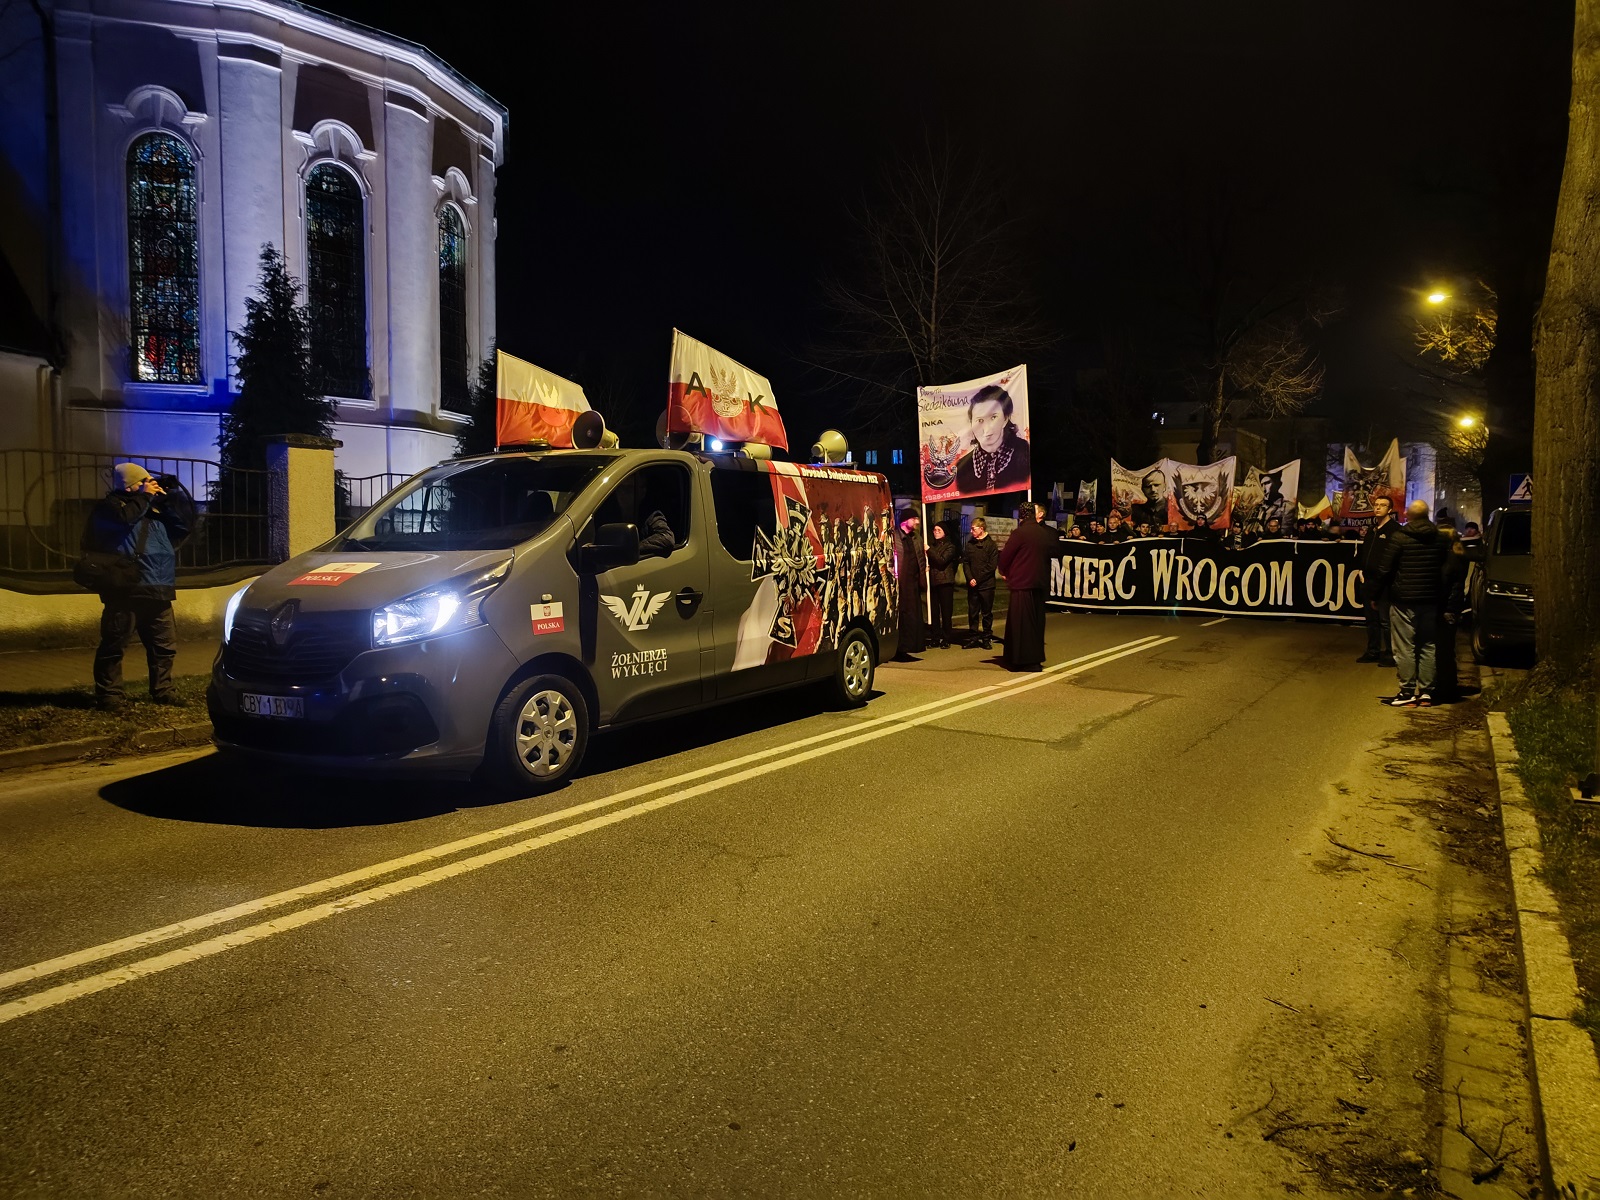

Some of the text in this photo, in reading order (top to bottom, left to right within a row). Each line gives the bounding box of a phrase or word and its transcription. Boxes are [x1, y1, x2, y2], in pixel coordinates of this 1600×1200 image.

[685, 371, 771, 416] A K
[922, 419, 944, 428] INKA
[1050, 546, 1365, 611] MIERĆ WROGOM OJC
[537, 621, 561, 631] POLSKA
[611, 648, 668, 667] ŻOŁNIERZE
[611, 660, 668, 680] WYKLĘCI
[244, 694, 262, 713] CBY
